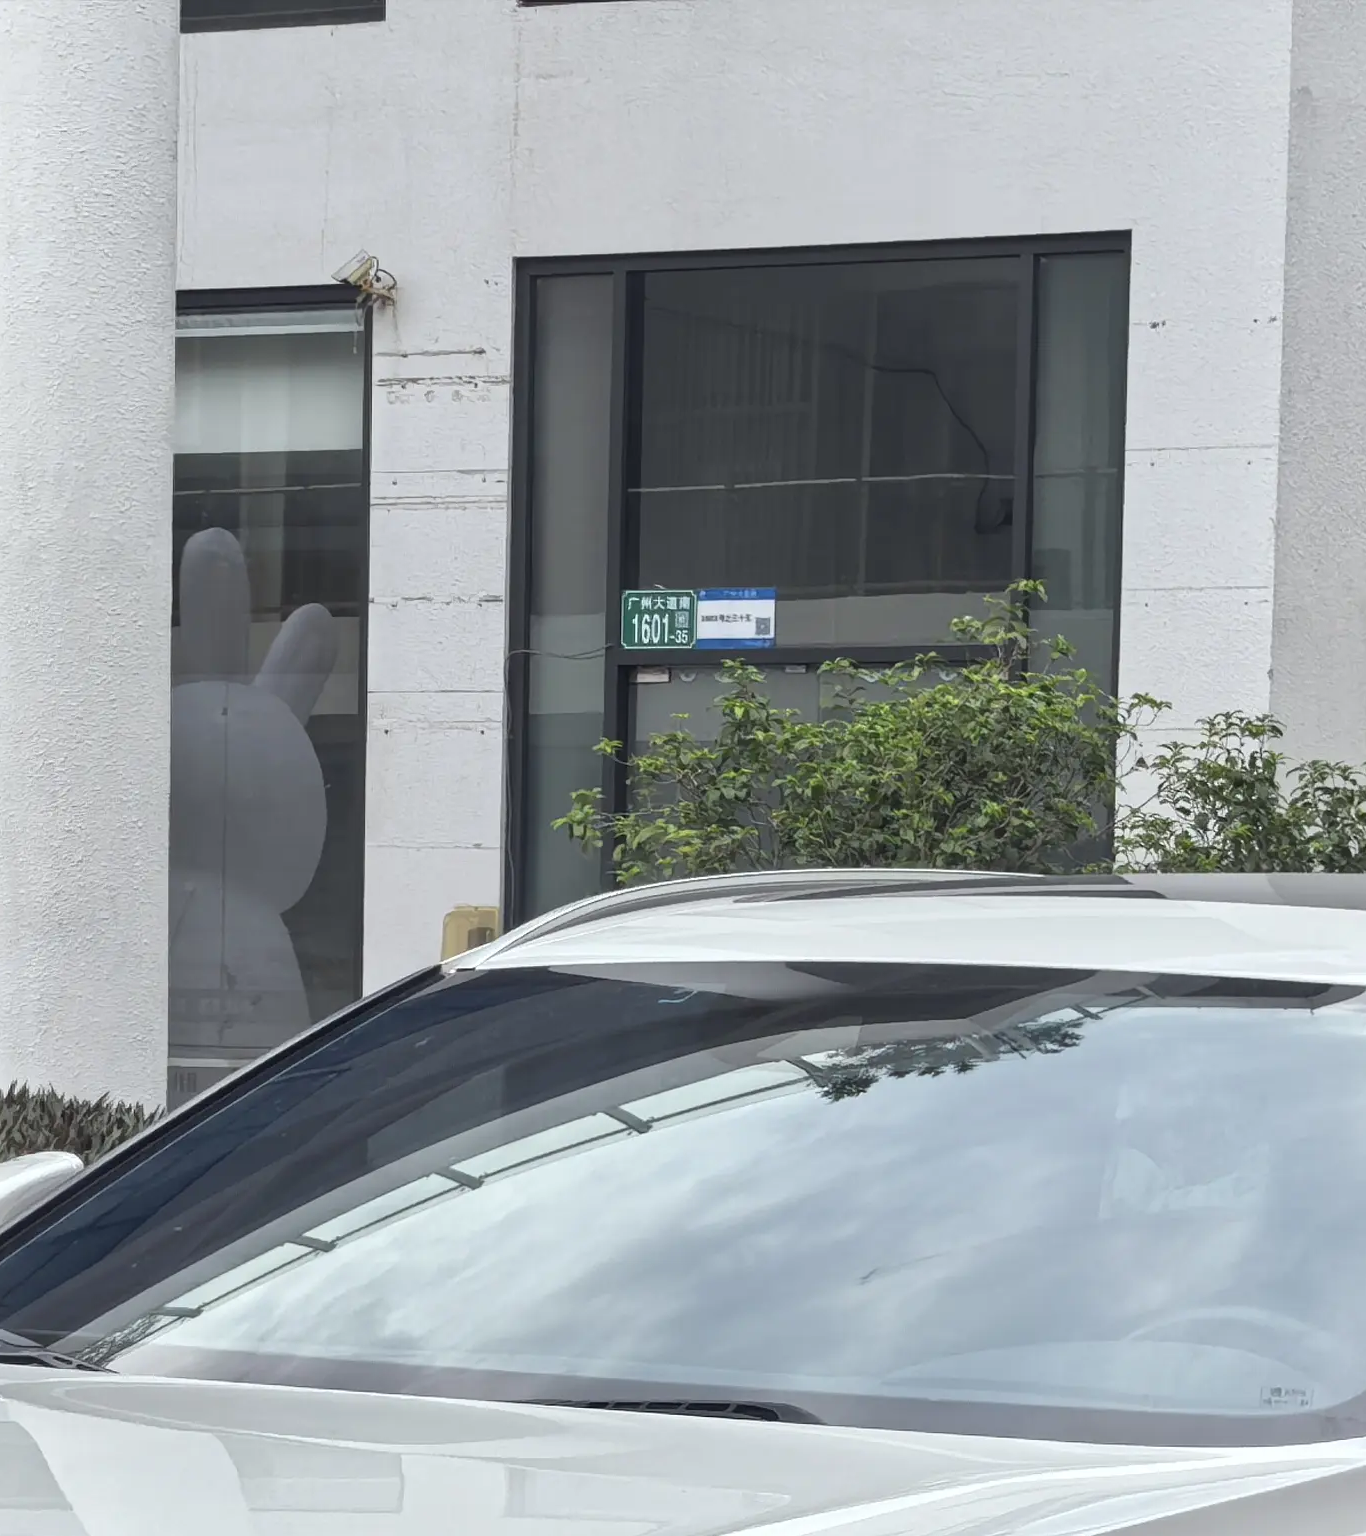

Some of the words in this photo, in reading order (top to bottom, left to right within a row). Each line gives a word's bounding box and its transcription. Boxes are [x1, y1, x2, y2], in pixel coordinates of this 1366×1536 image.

[627, 595, 691, 610] 广州大道南
